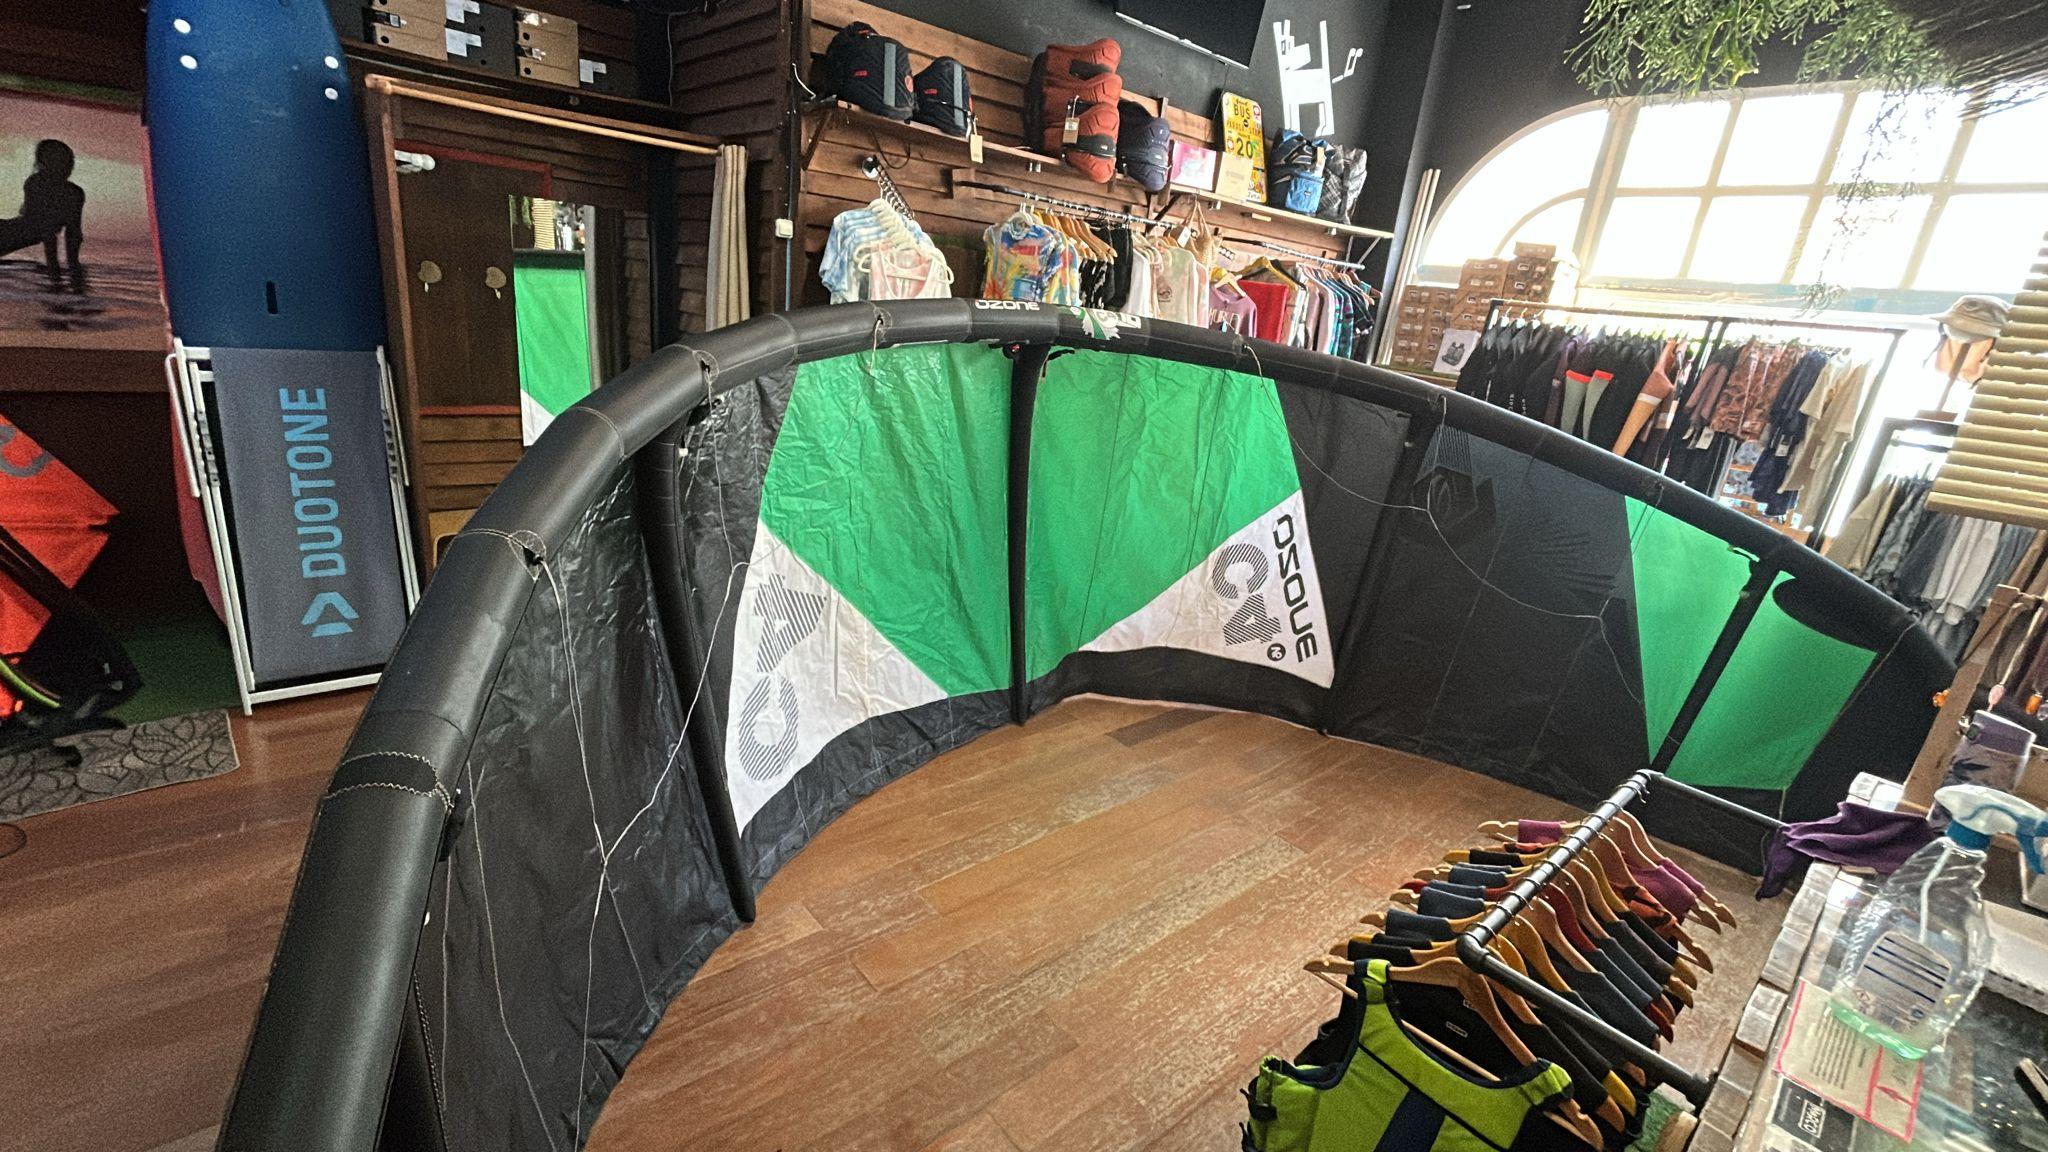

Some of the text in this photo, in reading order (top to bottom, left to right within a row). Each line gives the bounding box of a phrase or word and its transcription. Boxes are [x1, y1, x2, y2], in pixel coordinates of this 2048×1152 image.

[1234, 104, 1251, 120] BUS
[1236, 138, 1254, 159] 20
[279, 387, 347, 579] DUOTONE
